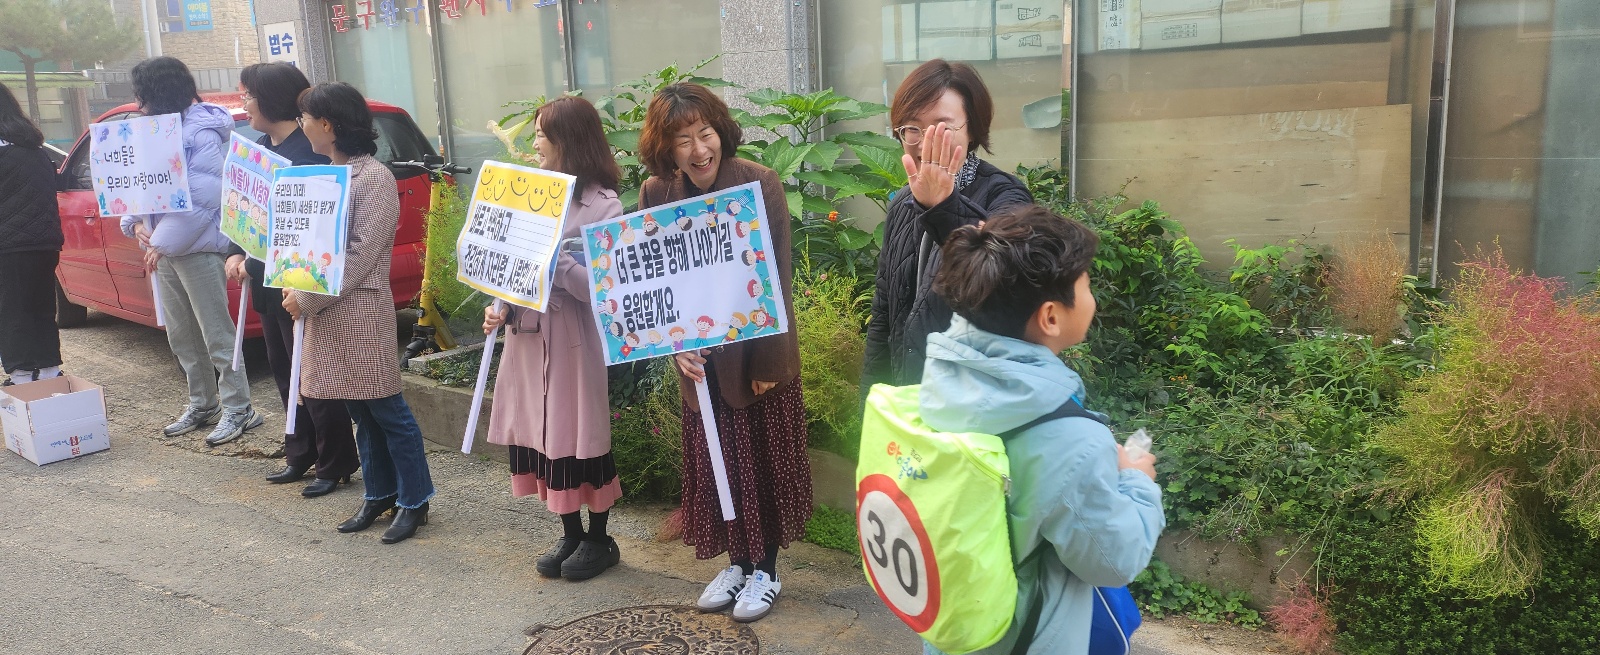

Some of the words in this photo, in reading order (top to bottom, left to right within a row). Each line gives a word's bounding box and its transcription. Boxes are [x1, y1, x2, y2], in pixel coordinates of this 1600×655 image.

[268, 32, 294, 56] 법수
[104, 145, 135, 167] 너희들은
[107, 175, 131, 193] 우리의
[133, 170, 173, 191] 자랑이야!
[275, 183, 292, 197] 우리의
[294, 183, 306, 197] 미래!
[275, 200, 297, 214] 너희들이
[298, 200, 313, 214] 세상을
[313, 200, 319, 214] 더
[320, 200, 336, 214] 밝게
[275, 216, 286, 230] 빛낼
[287, 216, 293, 230] 수
[294, 217, 310, 231] 있도록
[614, 246, 629, 285] 더
[627, 244, 642, 282] 큰
[639, 238, 665, 280] 꿈을
[663, 233, 690, 275] 향해
[689, 221, 734, 269] 나아가길
[622, 286, 681, 334] 응원할게요.
[867, 509, 918, 598] 30
